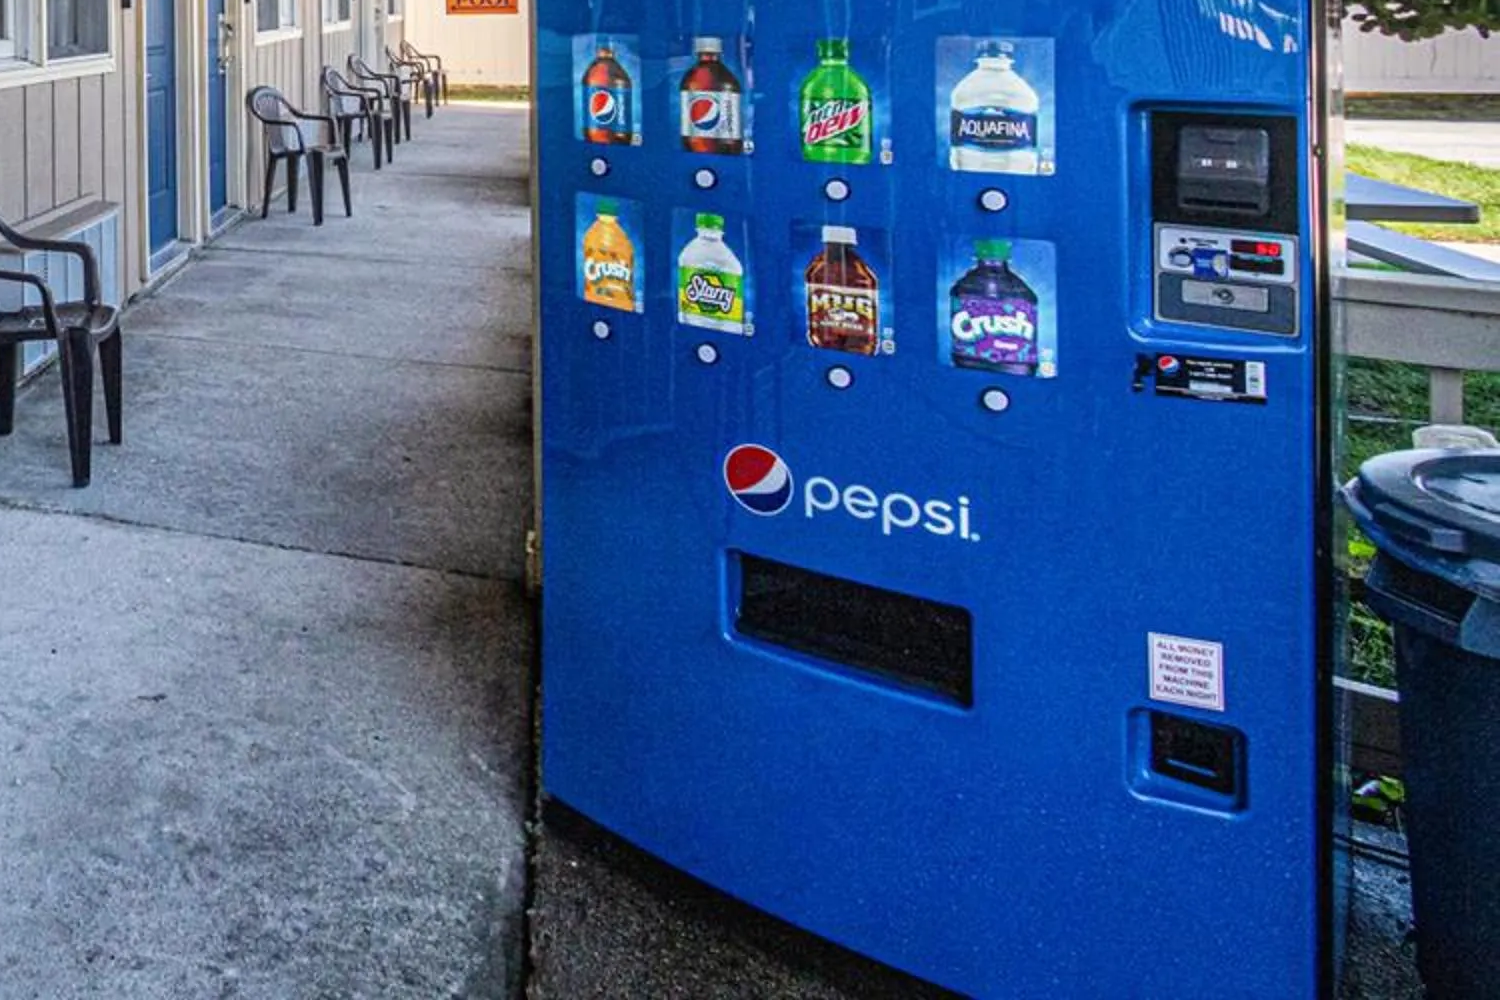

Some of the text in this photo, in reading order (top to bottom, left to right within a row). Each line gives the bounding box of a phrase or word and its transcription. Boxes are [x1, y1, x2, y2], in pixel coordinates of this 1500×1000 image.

[958, 119, 1031, 141] AQUAFINA
[584, 258, 630, 281] Crush
[686, 275, 734, 313] Starry
[811, 293, 874, 321] MUG
[952, 311, 1034, 341] Crush
[804, 476, 971, 540] pepsi
[1156, 641, 1214, 657] ALL MONEY
[1160, 652, 1211, 668] REMOVED
[1158, 663, 1214, 680] FROM THIS
[1162, 674, 1211, 690] MACHINE
[1155, 684, 1217, 702] EACH NIGHT
